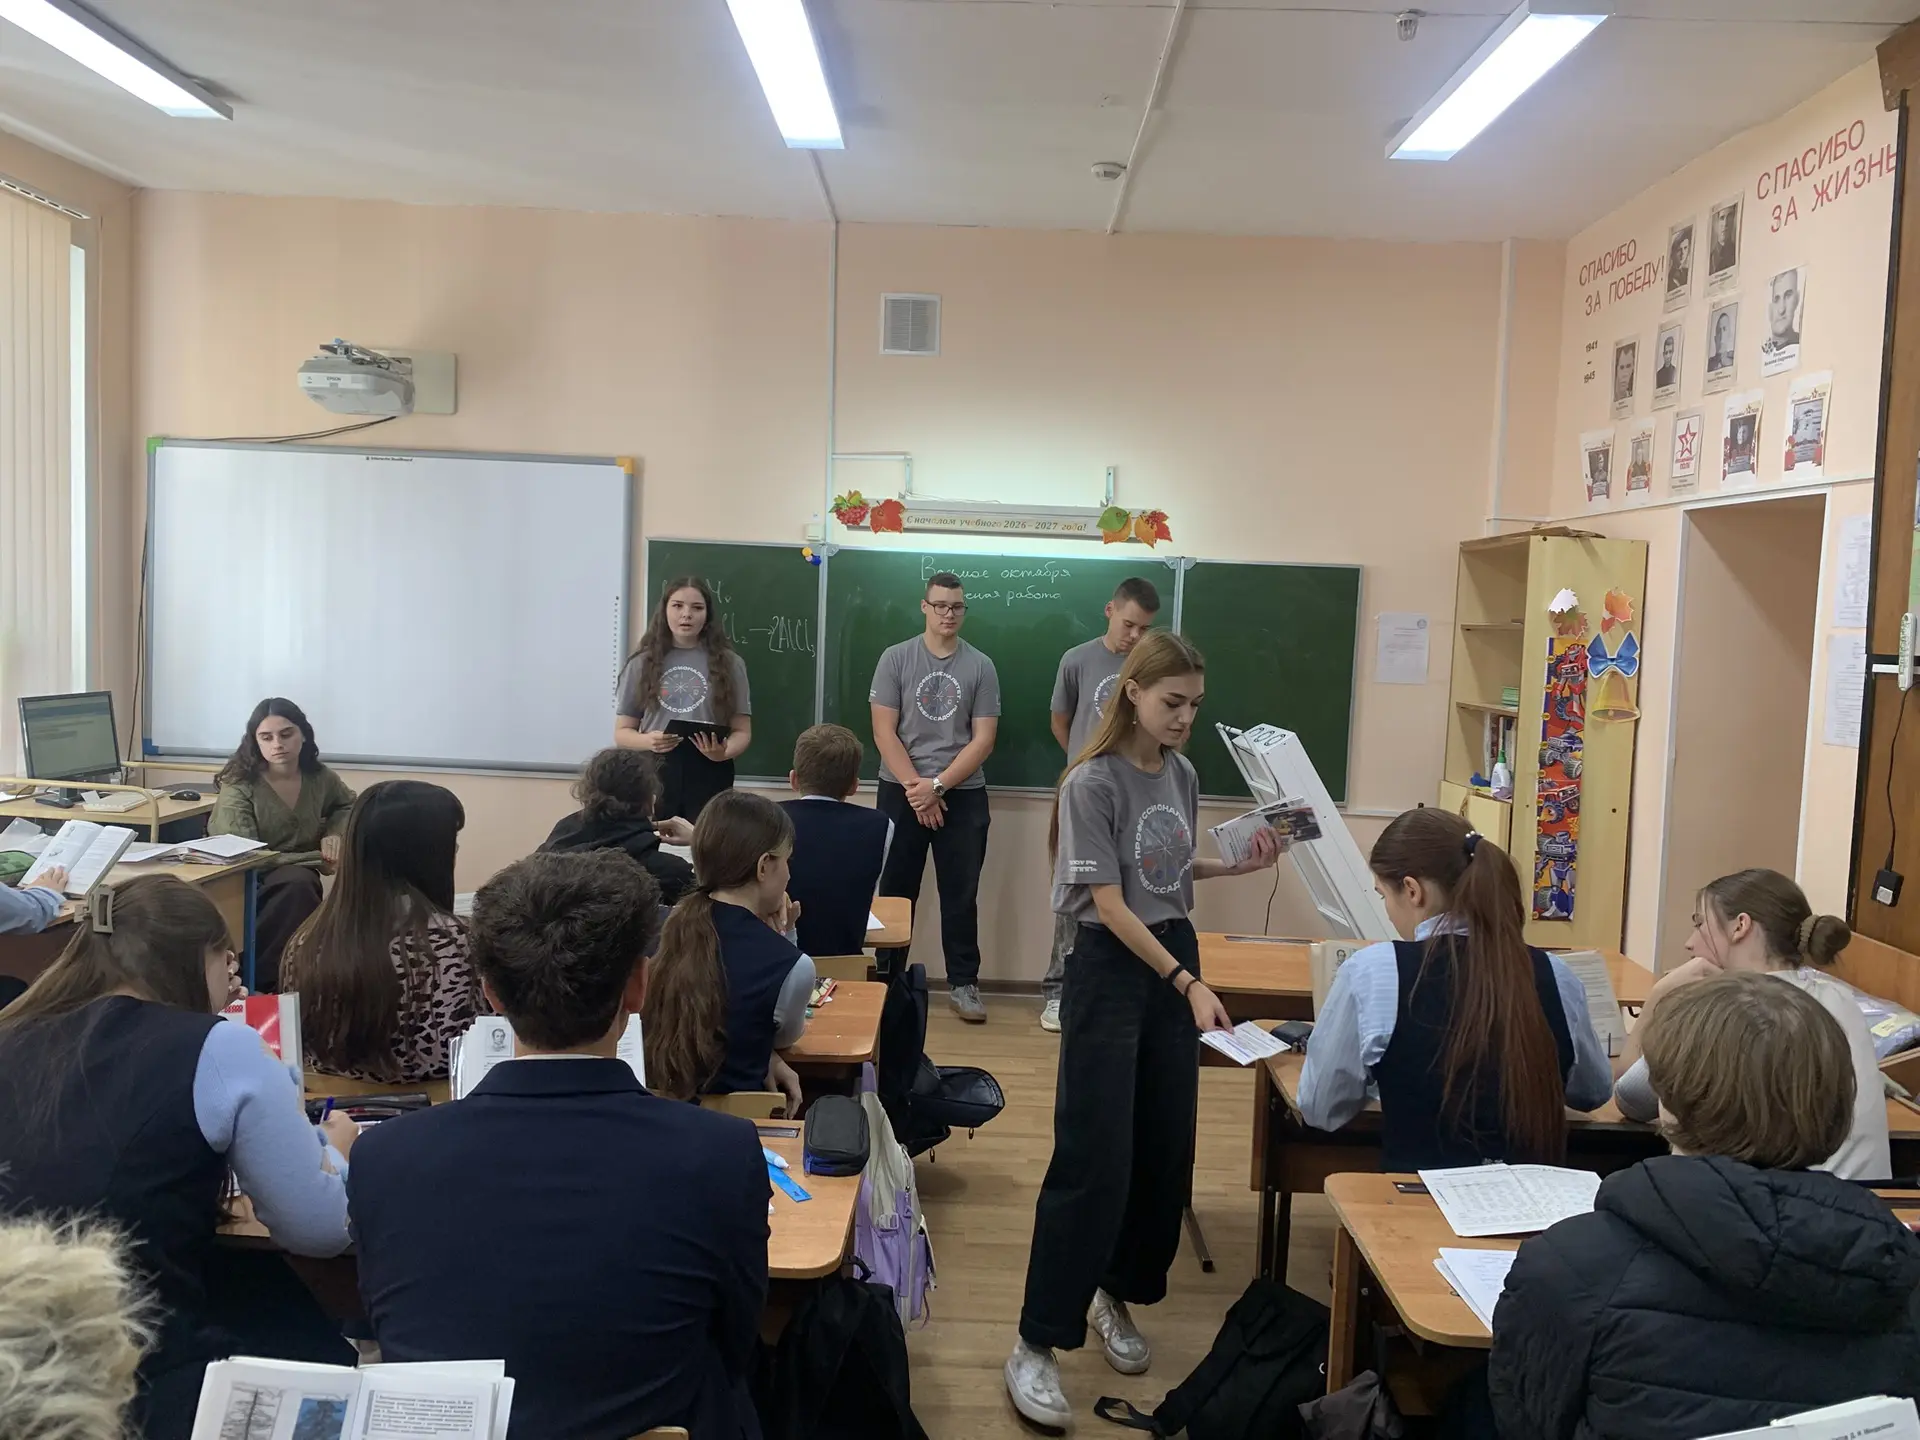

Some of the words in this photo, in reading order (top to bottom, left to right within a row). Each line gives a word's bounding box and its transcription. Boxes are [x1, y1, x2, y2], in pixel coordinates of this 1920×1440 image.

[1757, 119, 1865, 200] СПАСИБО
[1771, 196, 1798, 233] ЗА
[1579, 239, 1636, 286] СПАСИБО
[1585, 290, 1601, 316] ЗА
[1609, 255, 1664, 305] ПОБЕДУ!
[907, 515, 913, 524] С
[914, 516, 956, 525] началом
[959, 518, 1002, 528] учебного
[1004, 520, 1027, 529] 2026
[1035, 521, 1058, 530] 2027
[1061, 522, 1087, 532] года!
[1000, 560, 1071, 584] октября
[1006, 585, 1061, 607] работа
